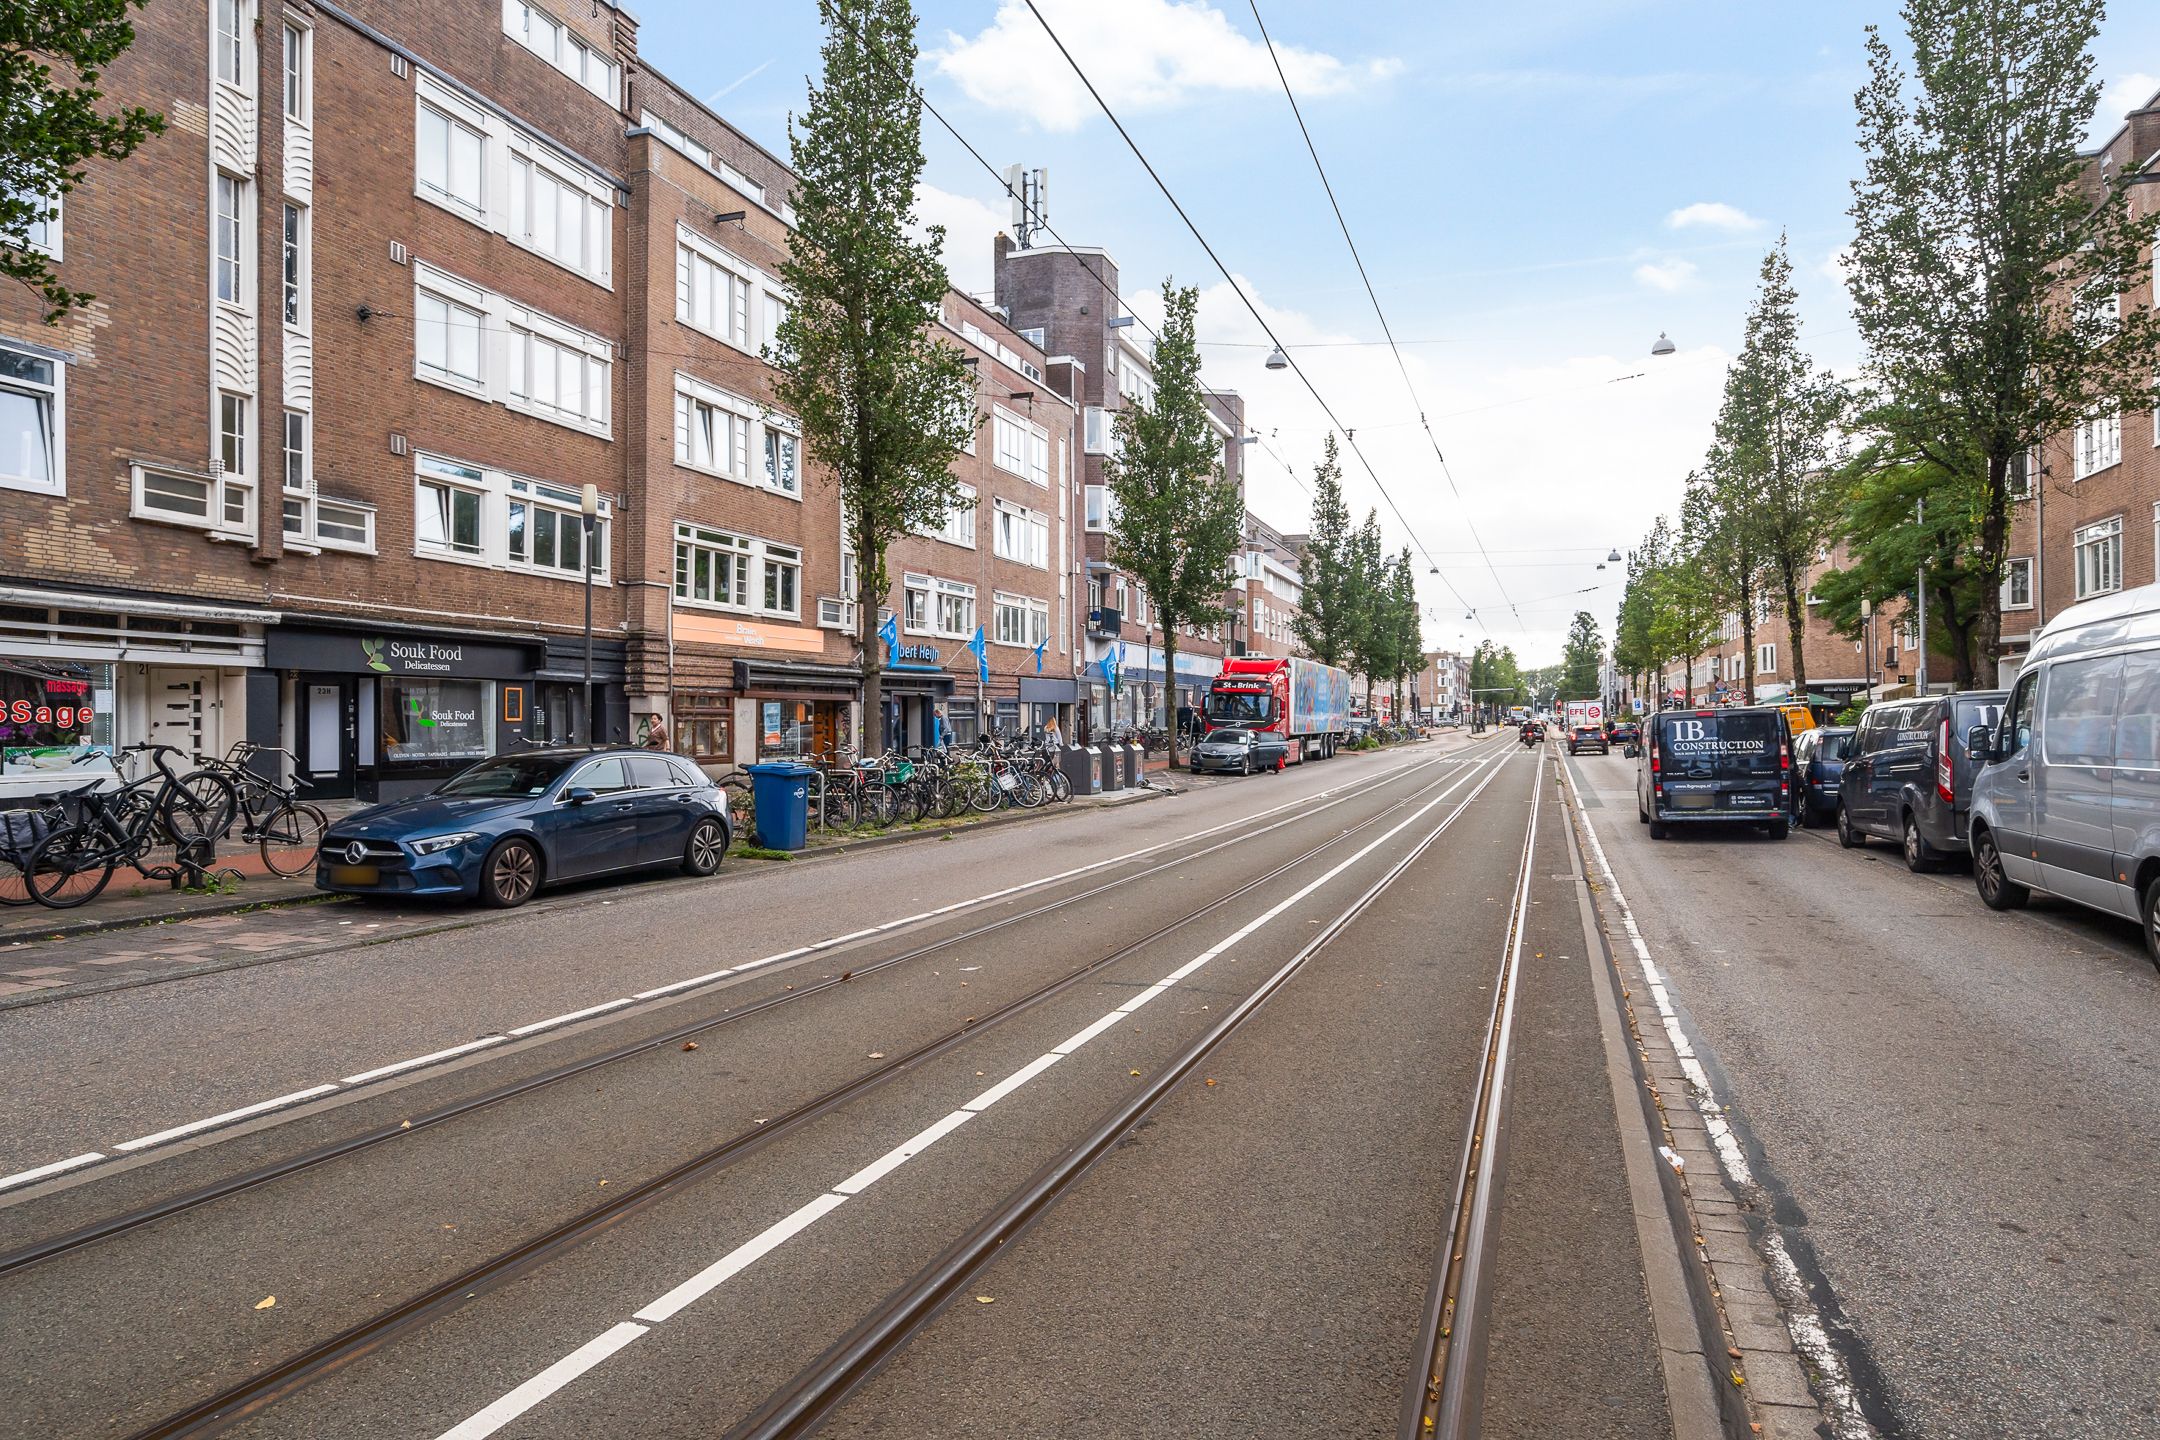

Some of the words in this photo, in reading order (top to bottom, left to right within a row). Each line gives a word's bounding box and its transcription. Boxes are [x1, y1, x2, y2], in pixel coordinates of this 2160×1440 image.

[736, 623, 757, 635] Brain
[390, 642, 426, 659] Souk
[429, 644, 462, 661] Food
[919, 645, 940, 663] Heijn
[139, 664, 149, 675] 21
[404, 660, 450, 671] Delicatessen
[46, 680, 89, 696] massage
[432, 710, 453, 720] Souk
[455, 710, 475, 720] Food
[1569, 708, 1585, 716] EFE
[1673, 720, 1705, 741] IB
[1897, 730, 1929, 742] CONSTRUCTION
[1673, 740, 1765, 751] CONSTRUCTION
